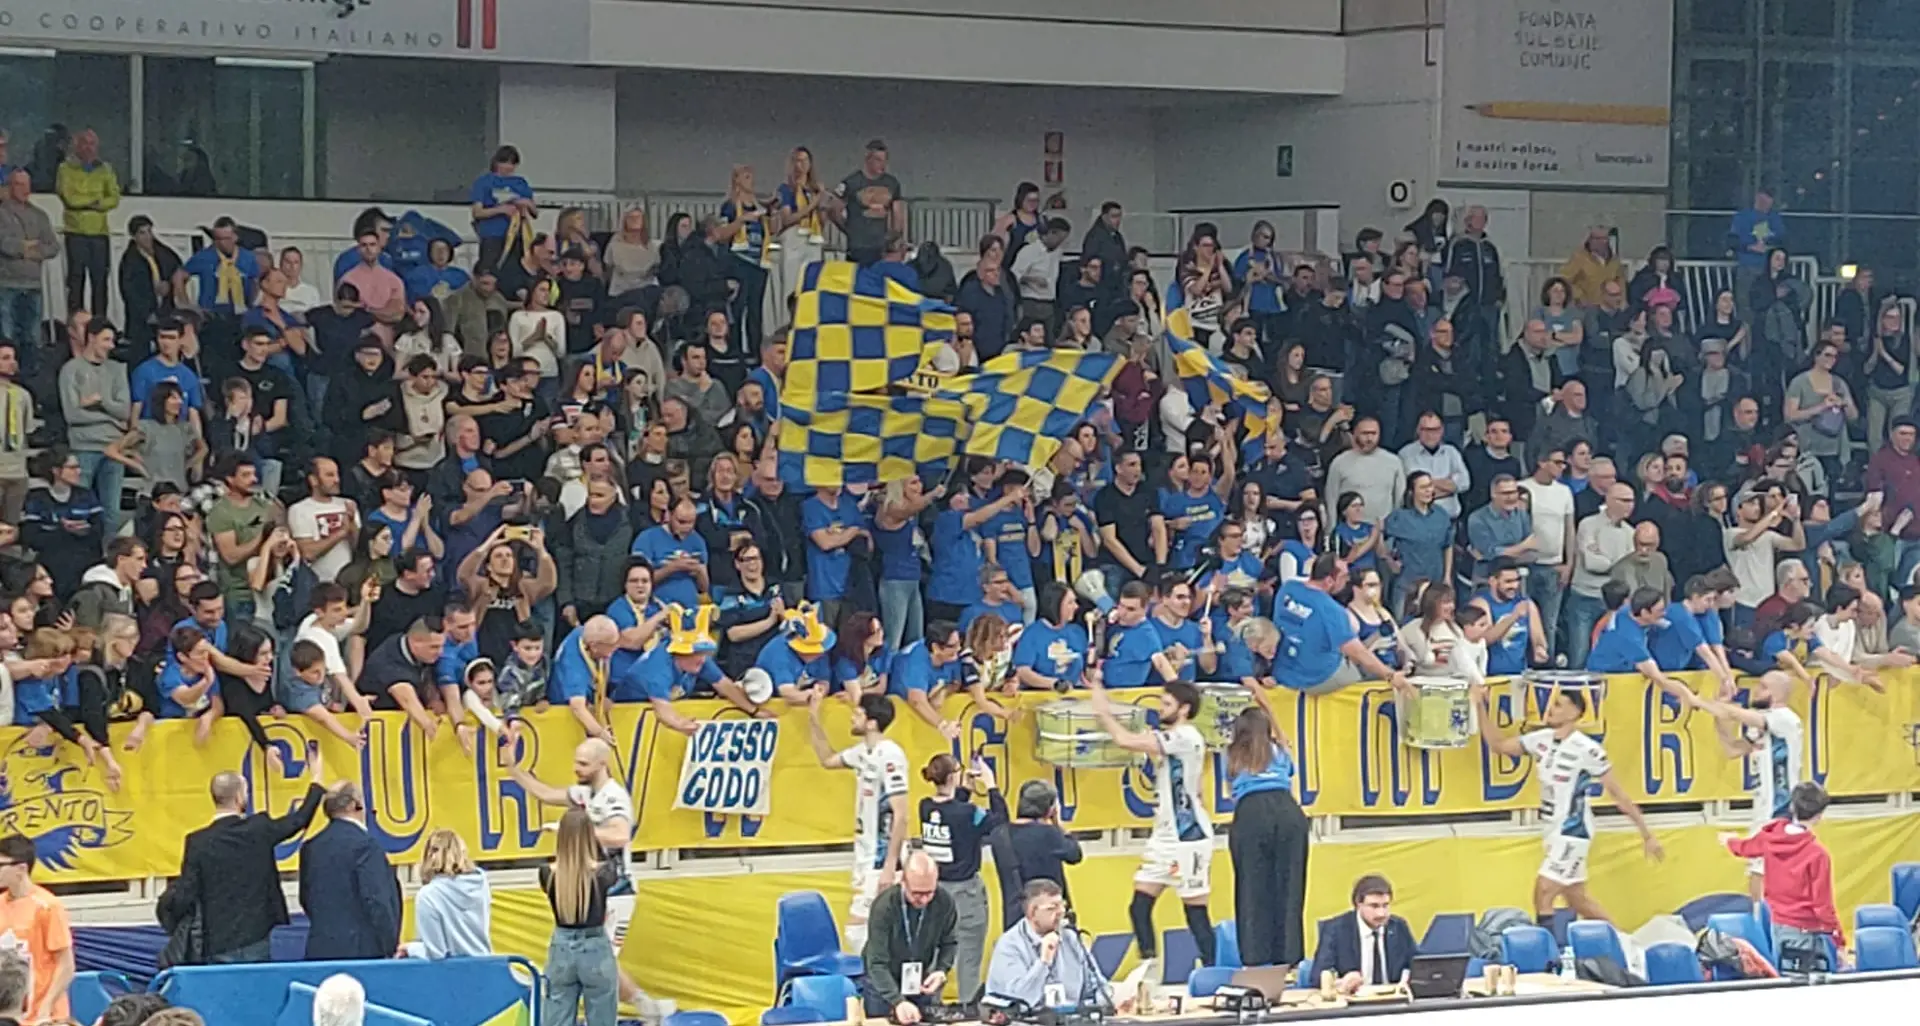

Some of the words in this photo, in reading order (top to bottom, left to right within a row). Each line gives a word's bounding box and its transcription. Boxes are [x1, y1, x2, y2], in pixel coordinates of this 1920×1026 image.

[39, 12, 272, 40] COOPERATIVO
[293, 25, 443, 48] ITALIANO
[1519, 11, 1597, 30] FONDATA
[682, 766, 761, 808] GODO
